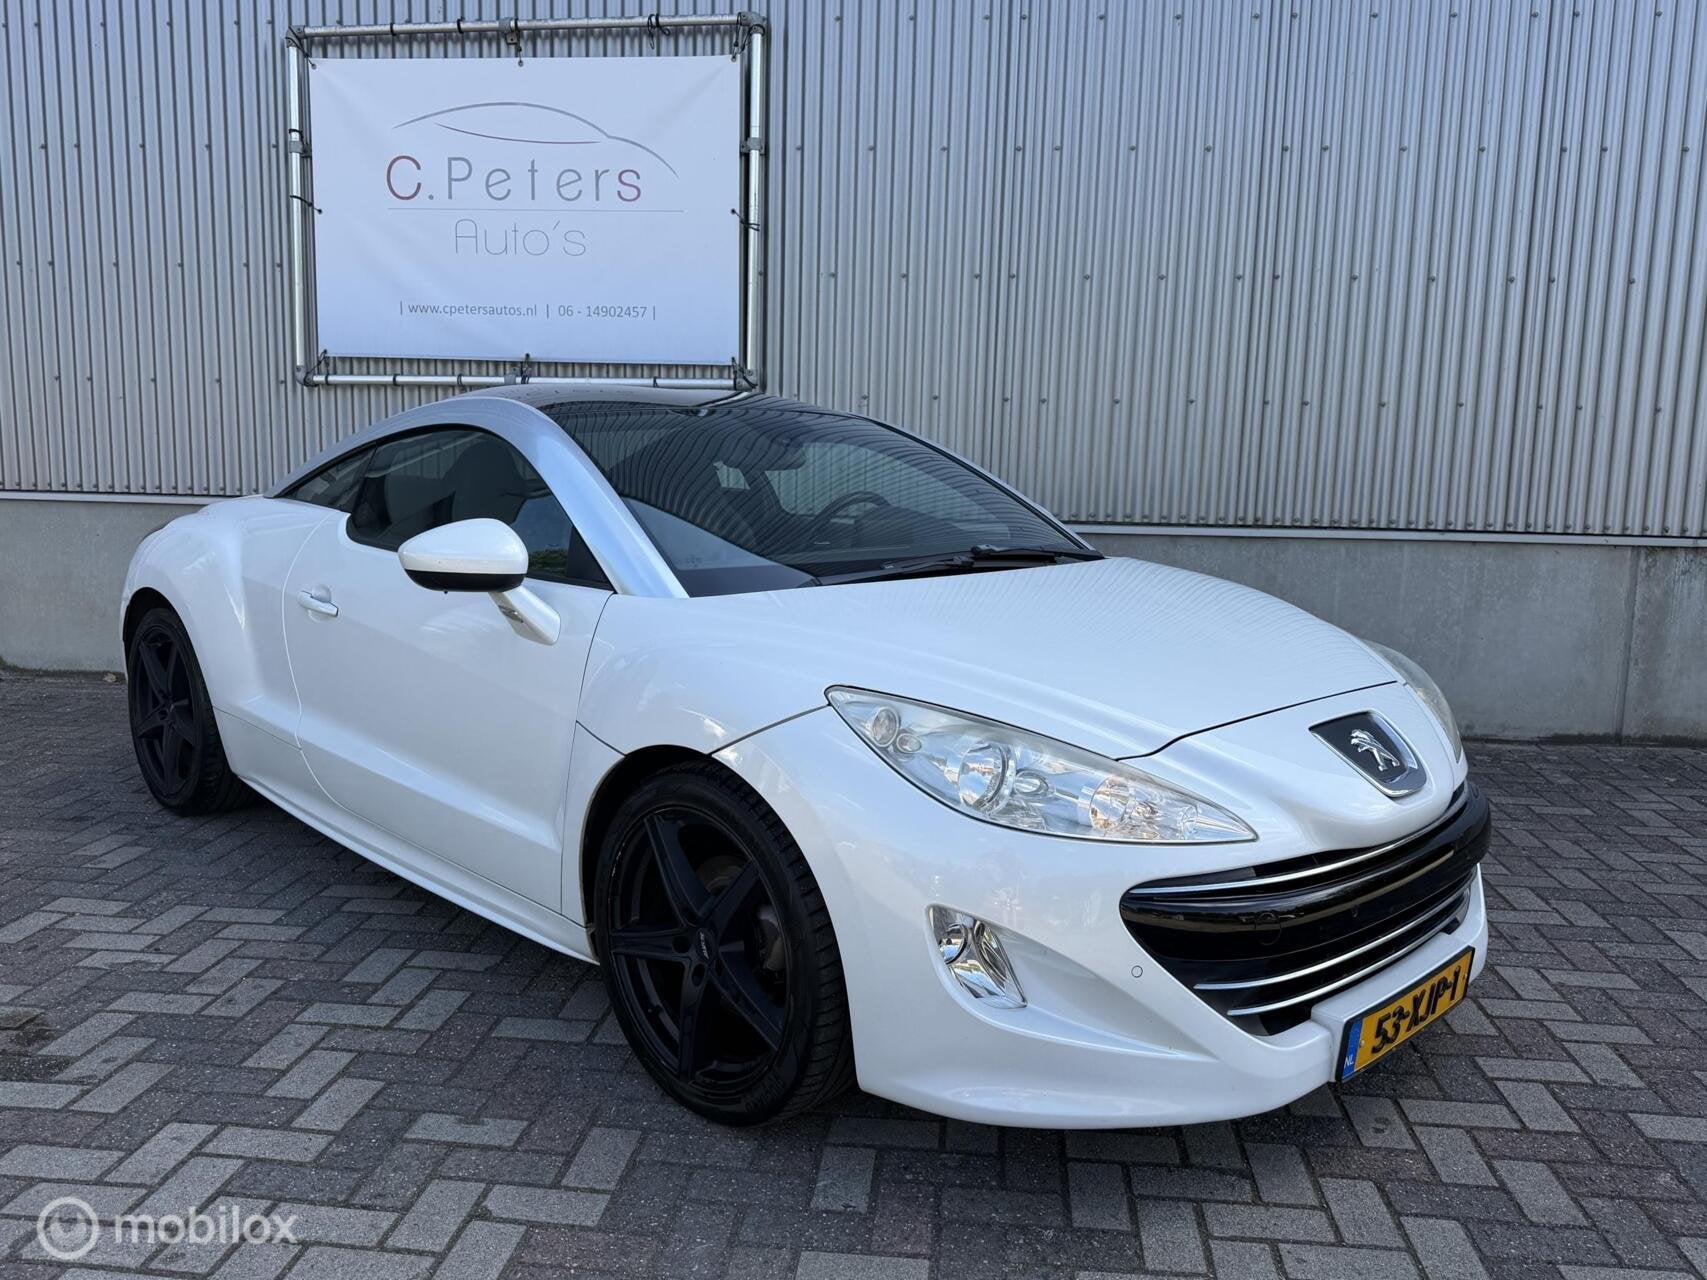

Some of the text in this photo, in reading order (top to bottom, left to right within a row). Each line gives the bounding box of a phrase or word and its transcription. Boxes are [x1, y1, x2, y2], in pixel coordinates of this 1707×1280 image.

[386, 155, 642, 202] C.Peters
[408, 302, 537, 317] www.cpetersautos.nl
[558, 305, 574, 317] 06
[585, 305, 647, 318] 14902457
[1371, 965, 1461, 1054] 53-XJP-1
